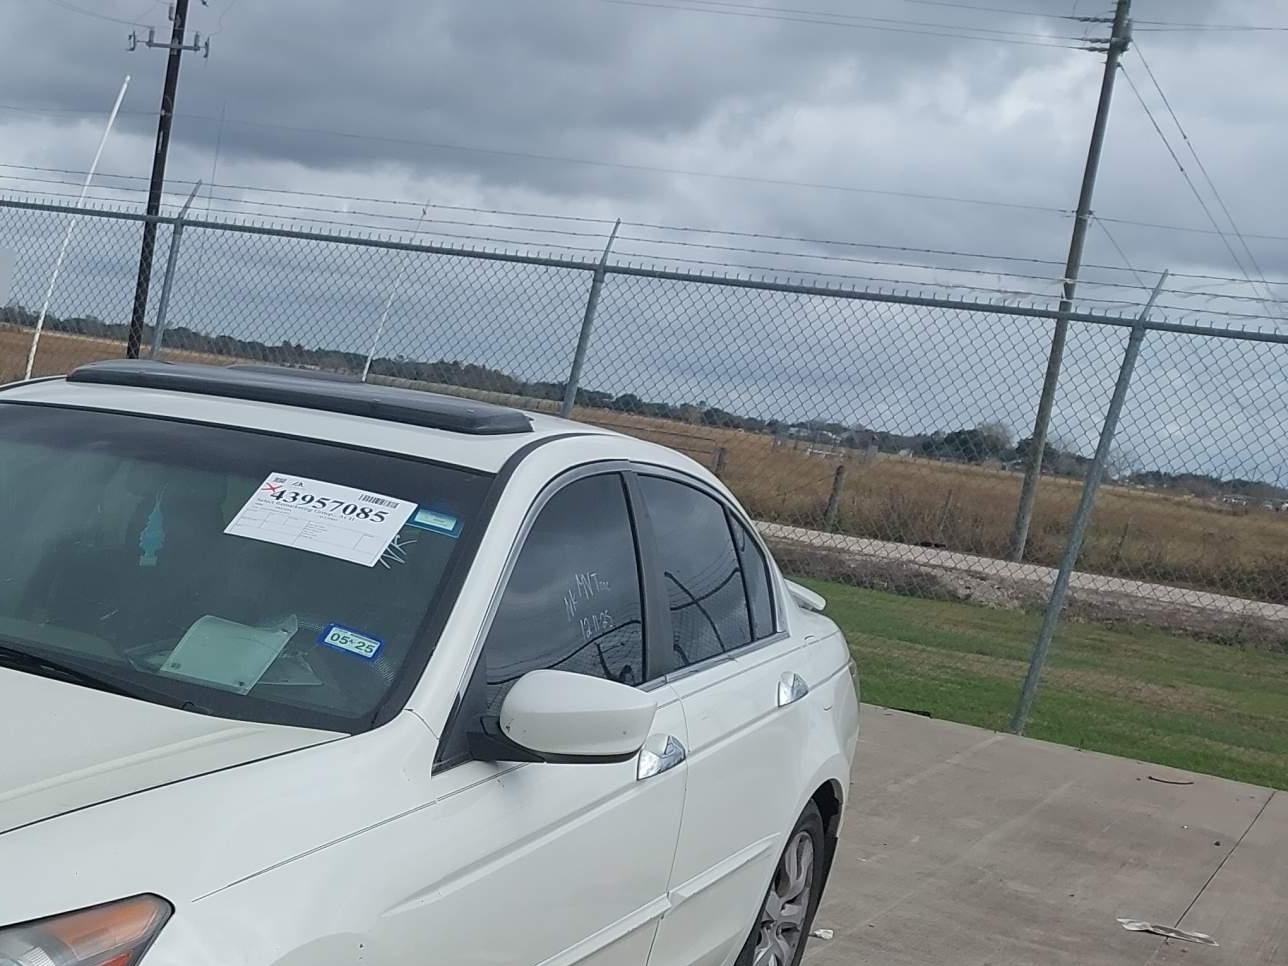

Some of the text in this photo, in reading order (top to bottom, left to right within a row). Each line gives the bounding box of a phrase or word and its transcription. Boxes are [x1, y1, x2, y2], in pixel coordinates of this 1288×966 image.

[270, 489, 391, 523] 43957085
[330, 632, 376, 654] 05 25
